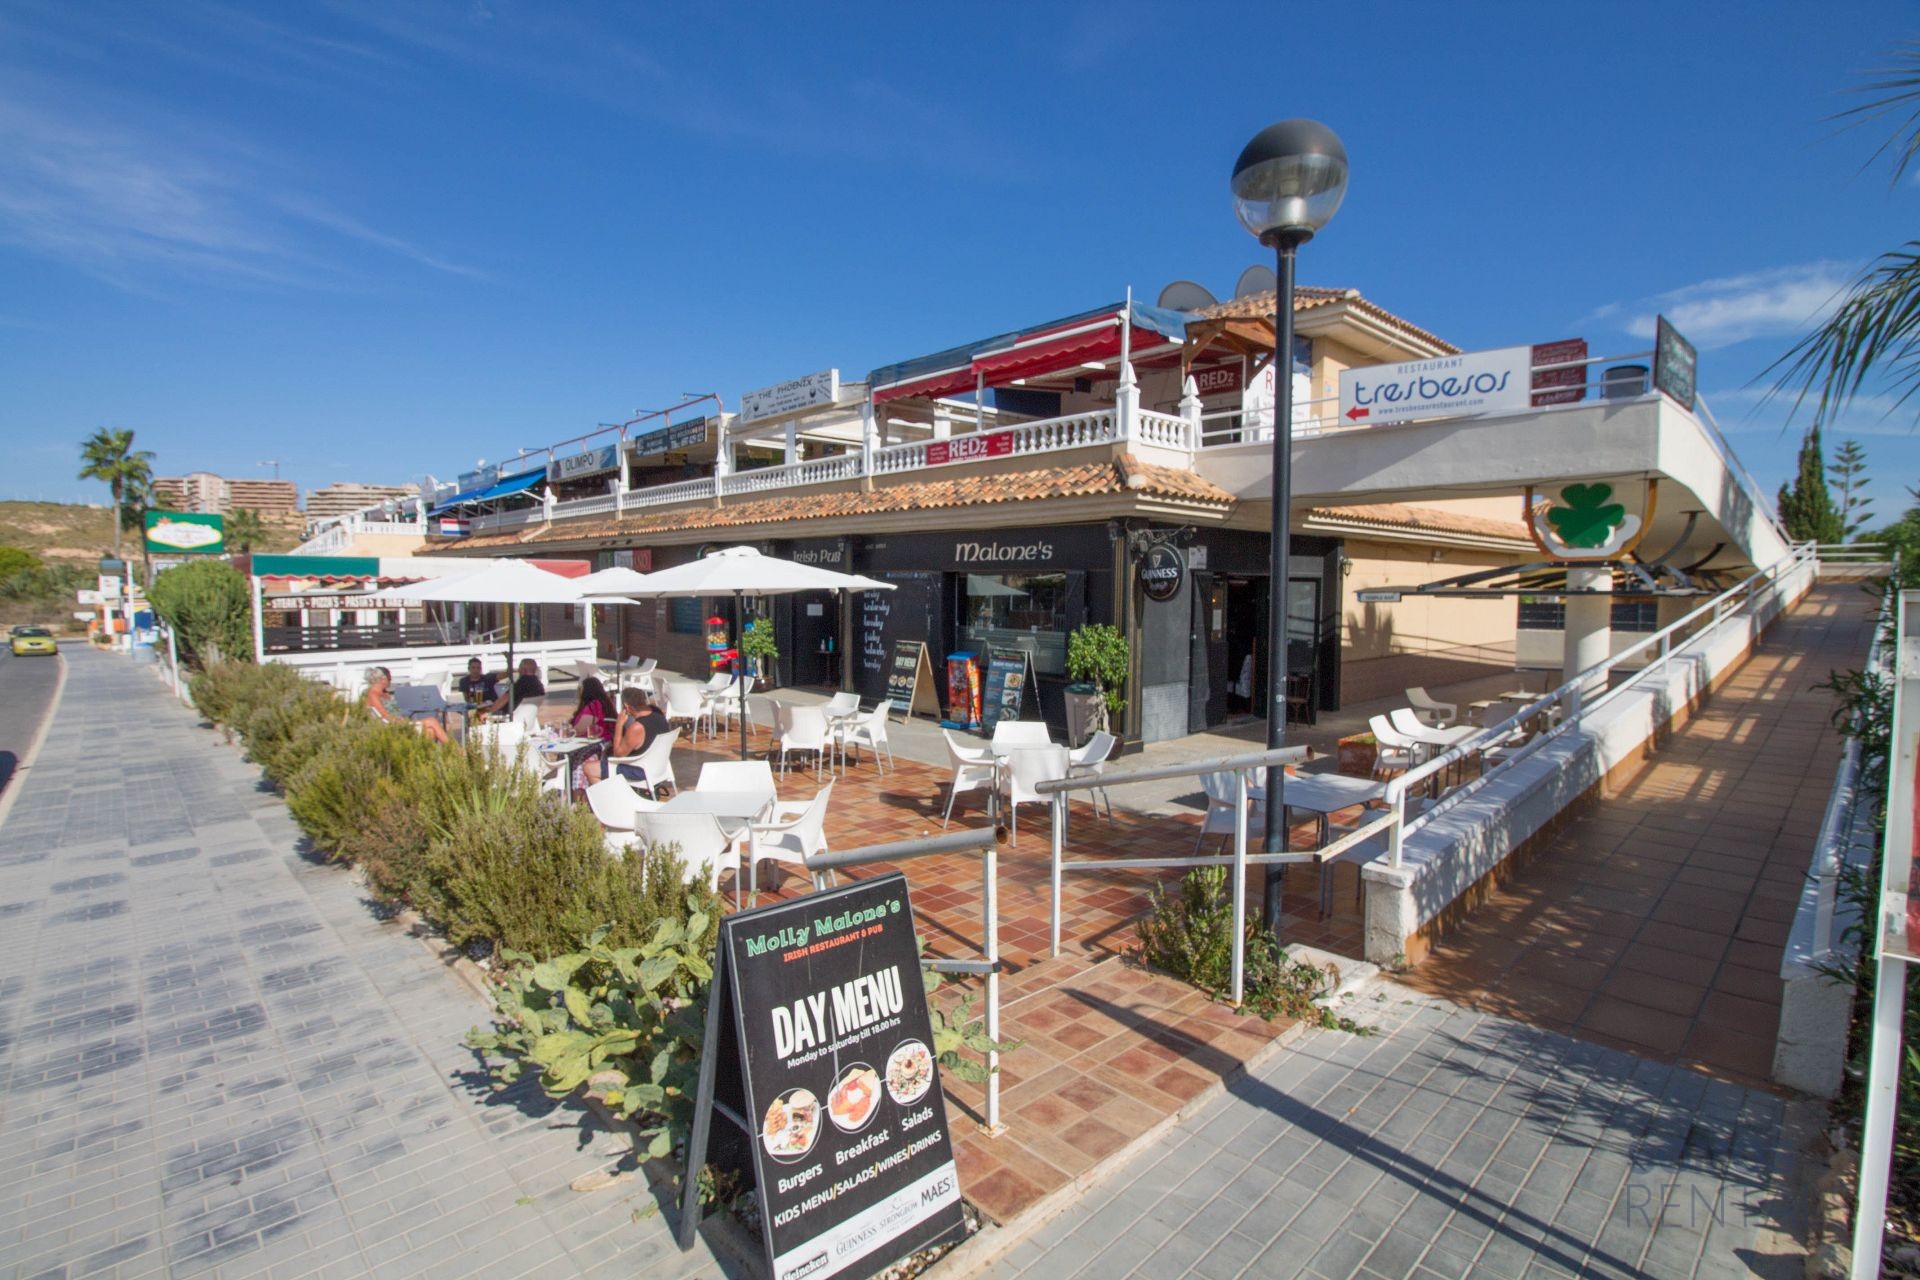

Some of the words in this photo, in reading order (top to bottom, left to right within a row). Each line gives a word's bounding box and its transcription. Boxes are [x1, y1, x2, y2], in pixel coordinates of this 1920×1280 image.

[1397, 358, 1463, 375] RESTAURANT
[758, 390, 773, 400] THE
[777, 378, 813, 395] PHOENIX
[1355, 371, 1511, 405] tresbesos
[1378, 399, 1484, 415] www.tresbesosrestaurant.com
[565, 453, 594, 471] OLIMPO
[1141, 567, 1178, 580] GUINNESS
[746, 927, 810, 957] Molly
[815, 899, 901, 937] Malone's
[784, 947, 809, 963] IRISH
[809, 931, 863, 956] RESTAURANT
[867, 923, 884, 936] PUB
[771, 991, 827, 1060] DAY
[831, 965, 903, 1036] MENU
[787, 1051, 818, 1070] Monday
[819, 1046, 828, 1057] to
[828, 1034, 861, 1053] saturday
[861, 1026, 872, 1040] till
[872, 1021, 891, 1037] 18.00
[890, 1016, 902, 1031] hrs
[778, 1163, 823, 1194] Burgers
[835, 1129, 890, 1166] Breakfast
[902, 1106, 934, 1132] Salads
[774, 1204, 801, 1228] KIDS
[836, 1223, 878, 1256] GUINNESS
[920, 1178, 951, 1208] MAES
